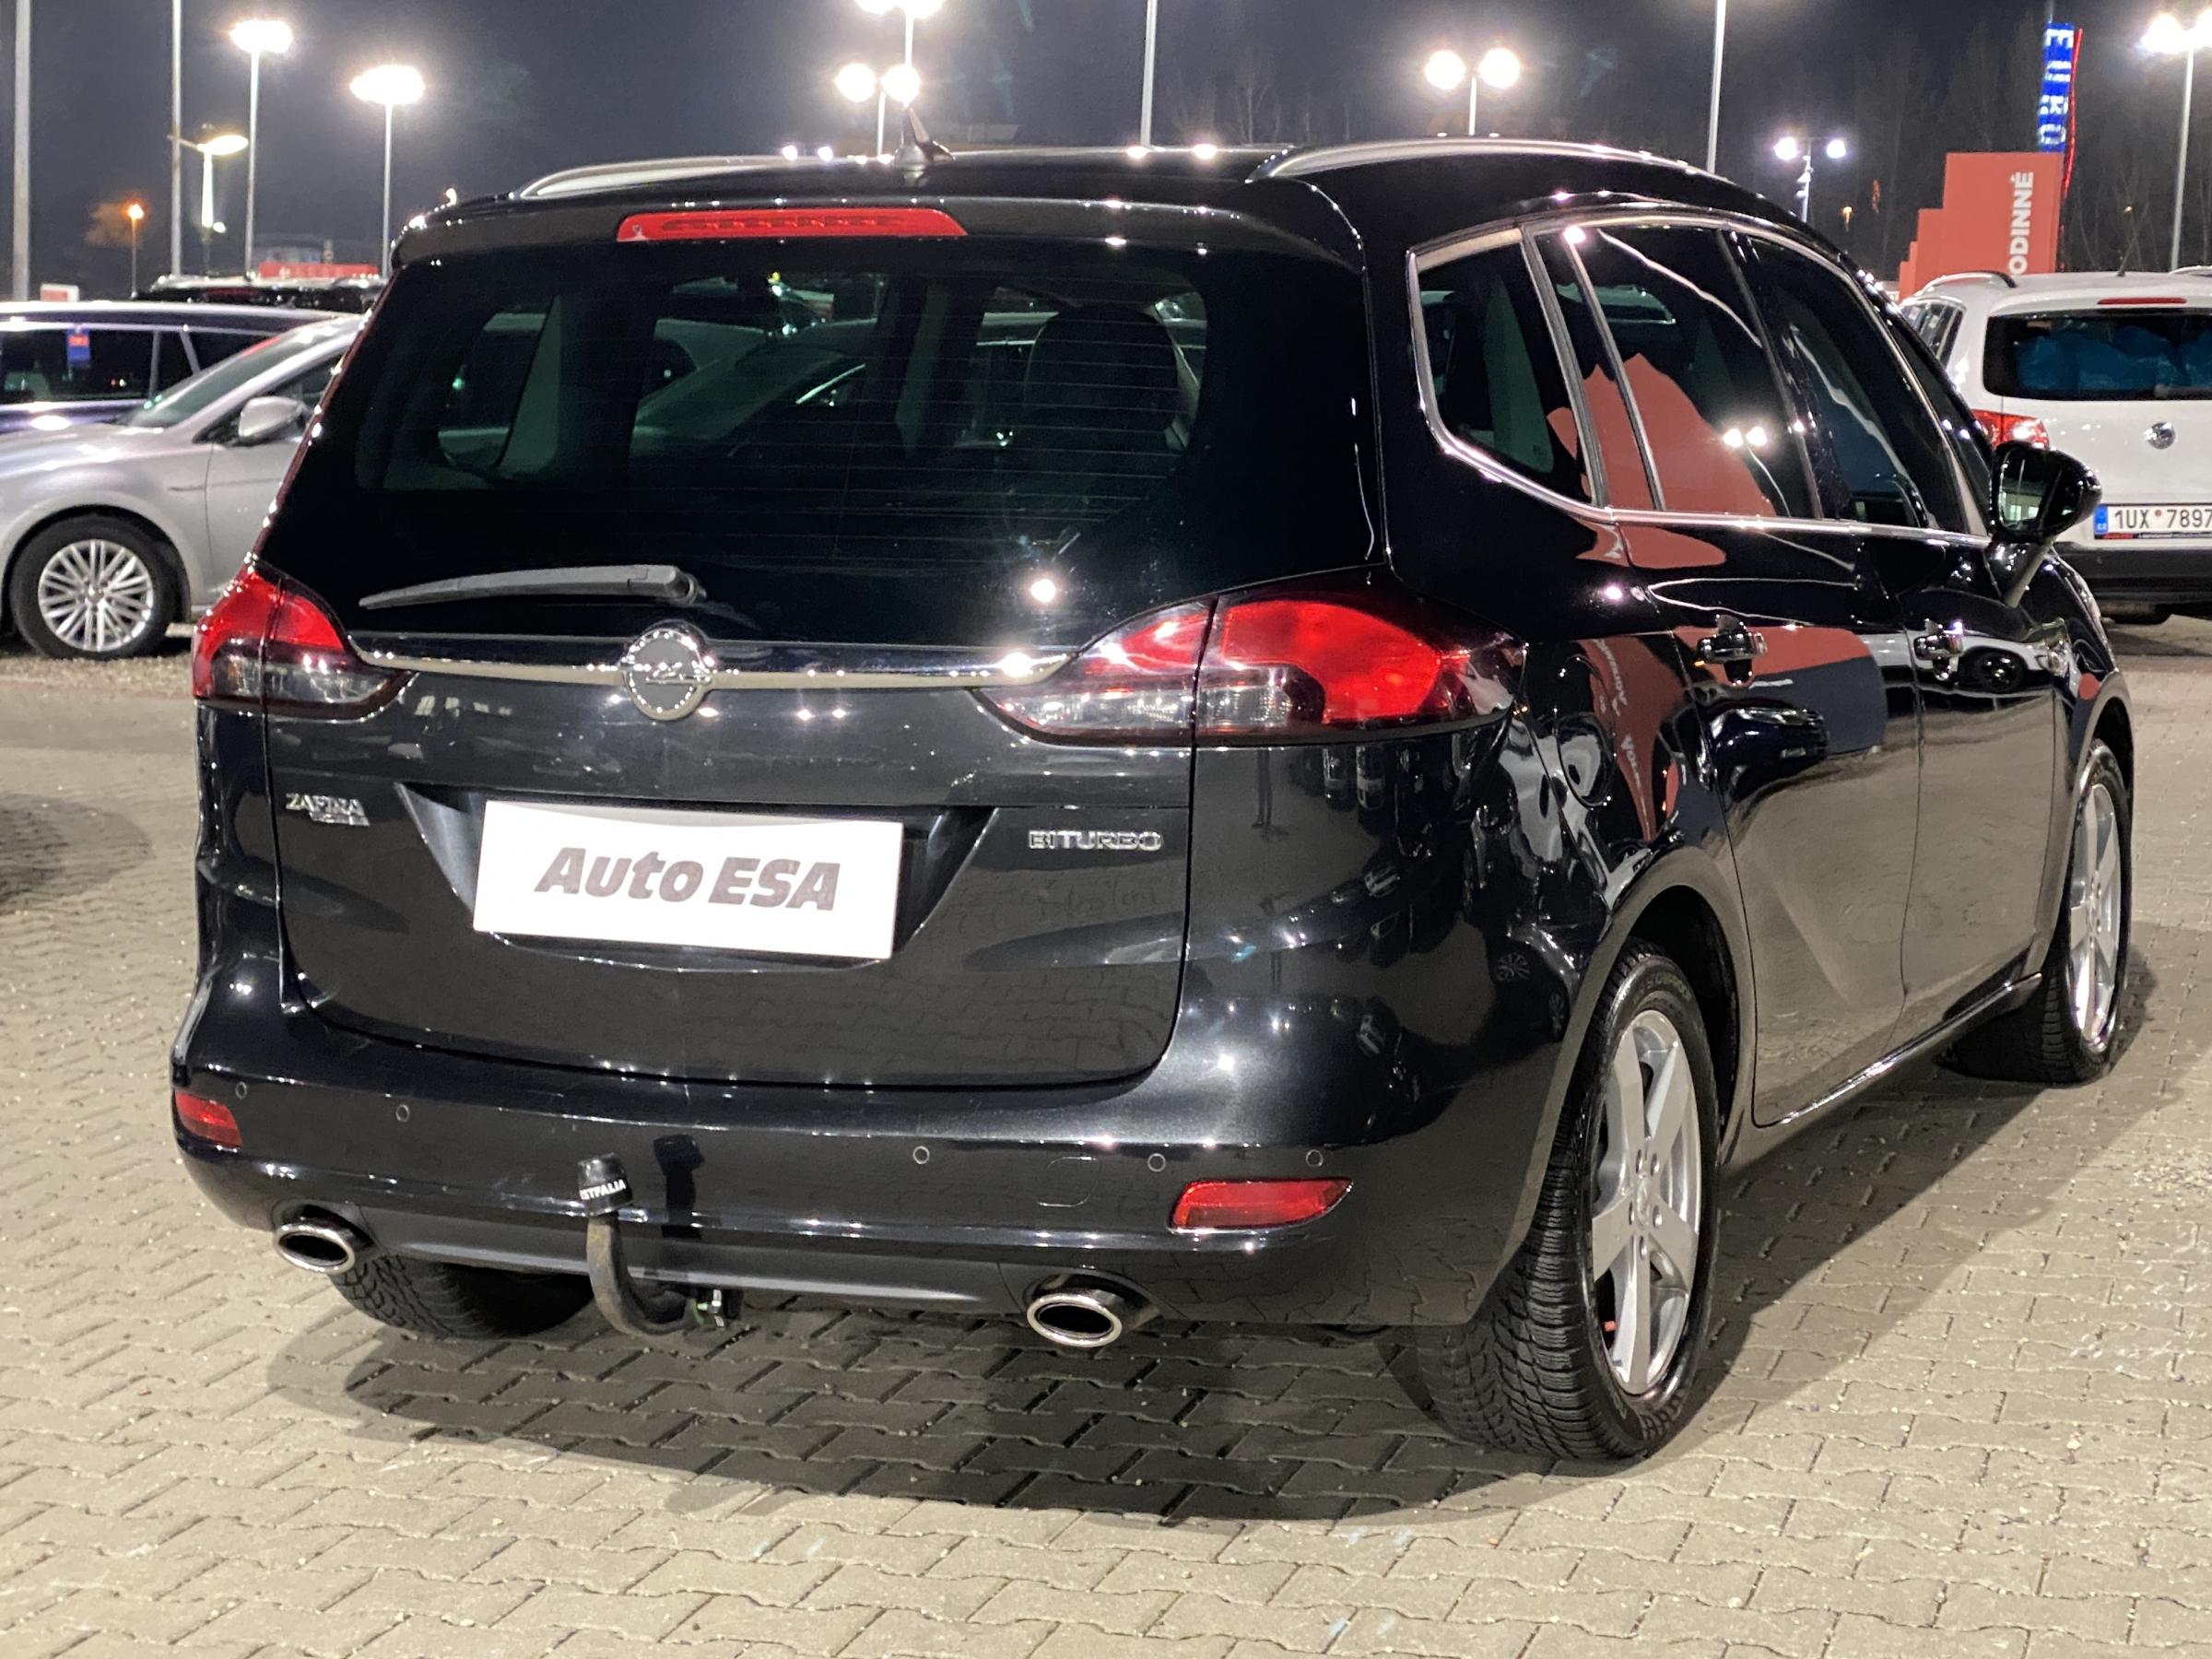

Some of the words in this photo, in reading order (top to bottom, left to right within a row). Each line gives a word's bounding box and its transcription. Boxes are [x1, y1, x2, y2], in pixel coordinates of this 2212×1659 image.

[2114, 509, 2149, 529] 1UX
[2167, 509, 2212, 528] 7897
[1029, 830, 1162, 851] BITURBO
[534, 847, 704, 902] Auto
[708, 857, 841, 911] ESA
